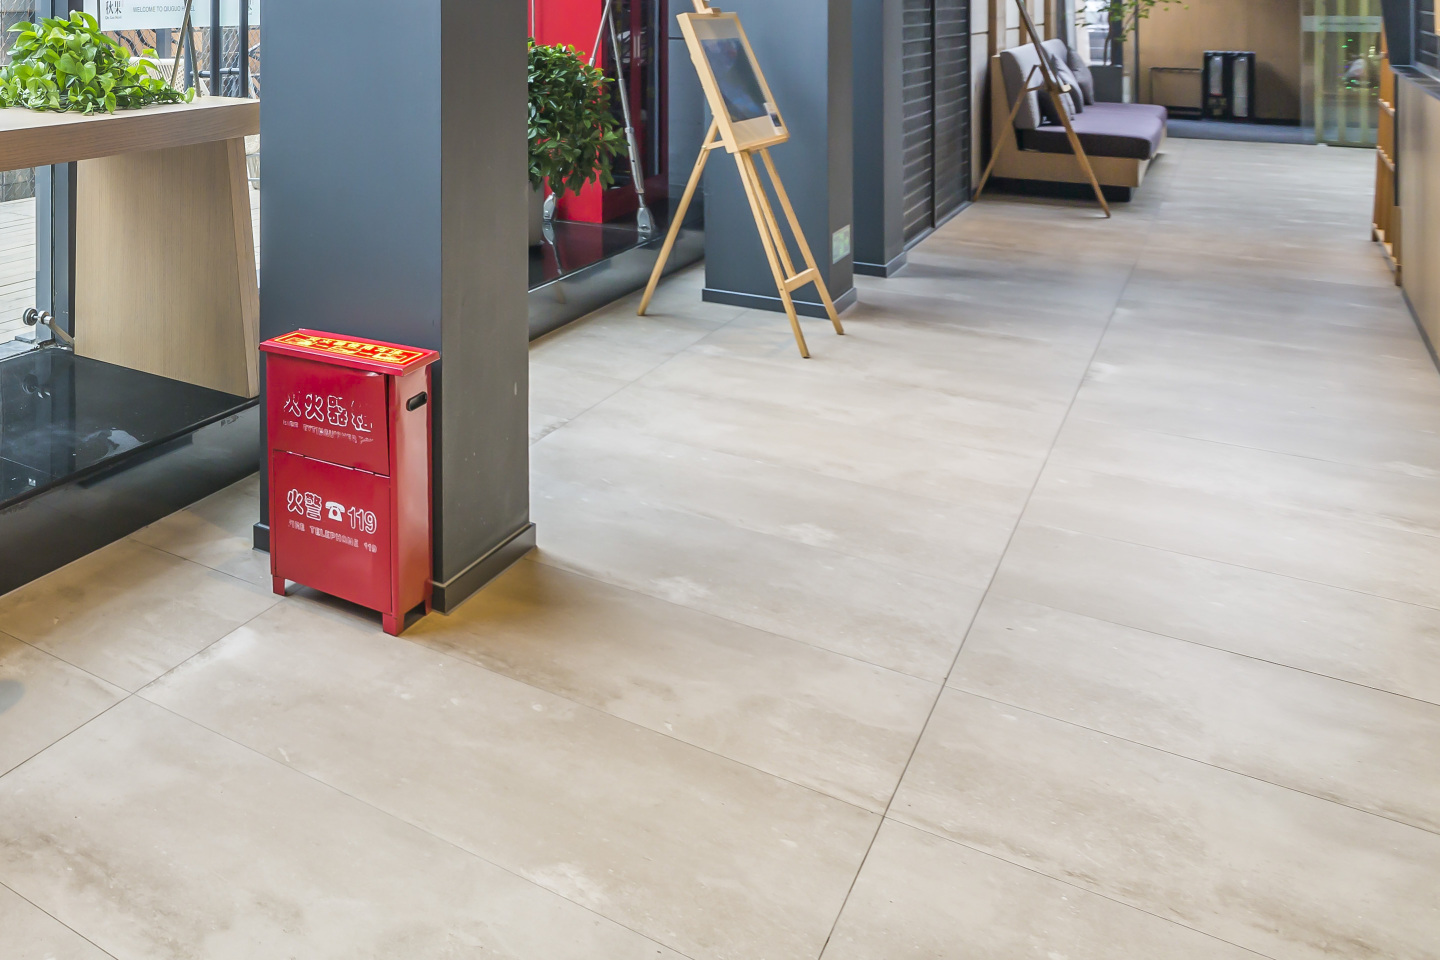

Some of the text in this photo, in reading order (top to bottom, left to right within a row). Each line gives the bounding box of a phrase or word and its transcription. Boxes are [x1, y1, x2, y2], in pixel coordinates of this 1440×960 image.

[105, 0, 122, 15] 秋果
[287, 488, 378, 535] 火警 119
[363, 542, 378, 553] 119
